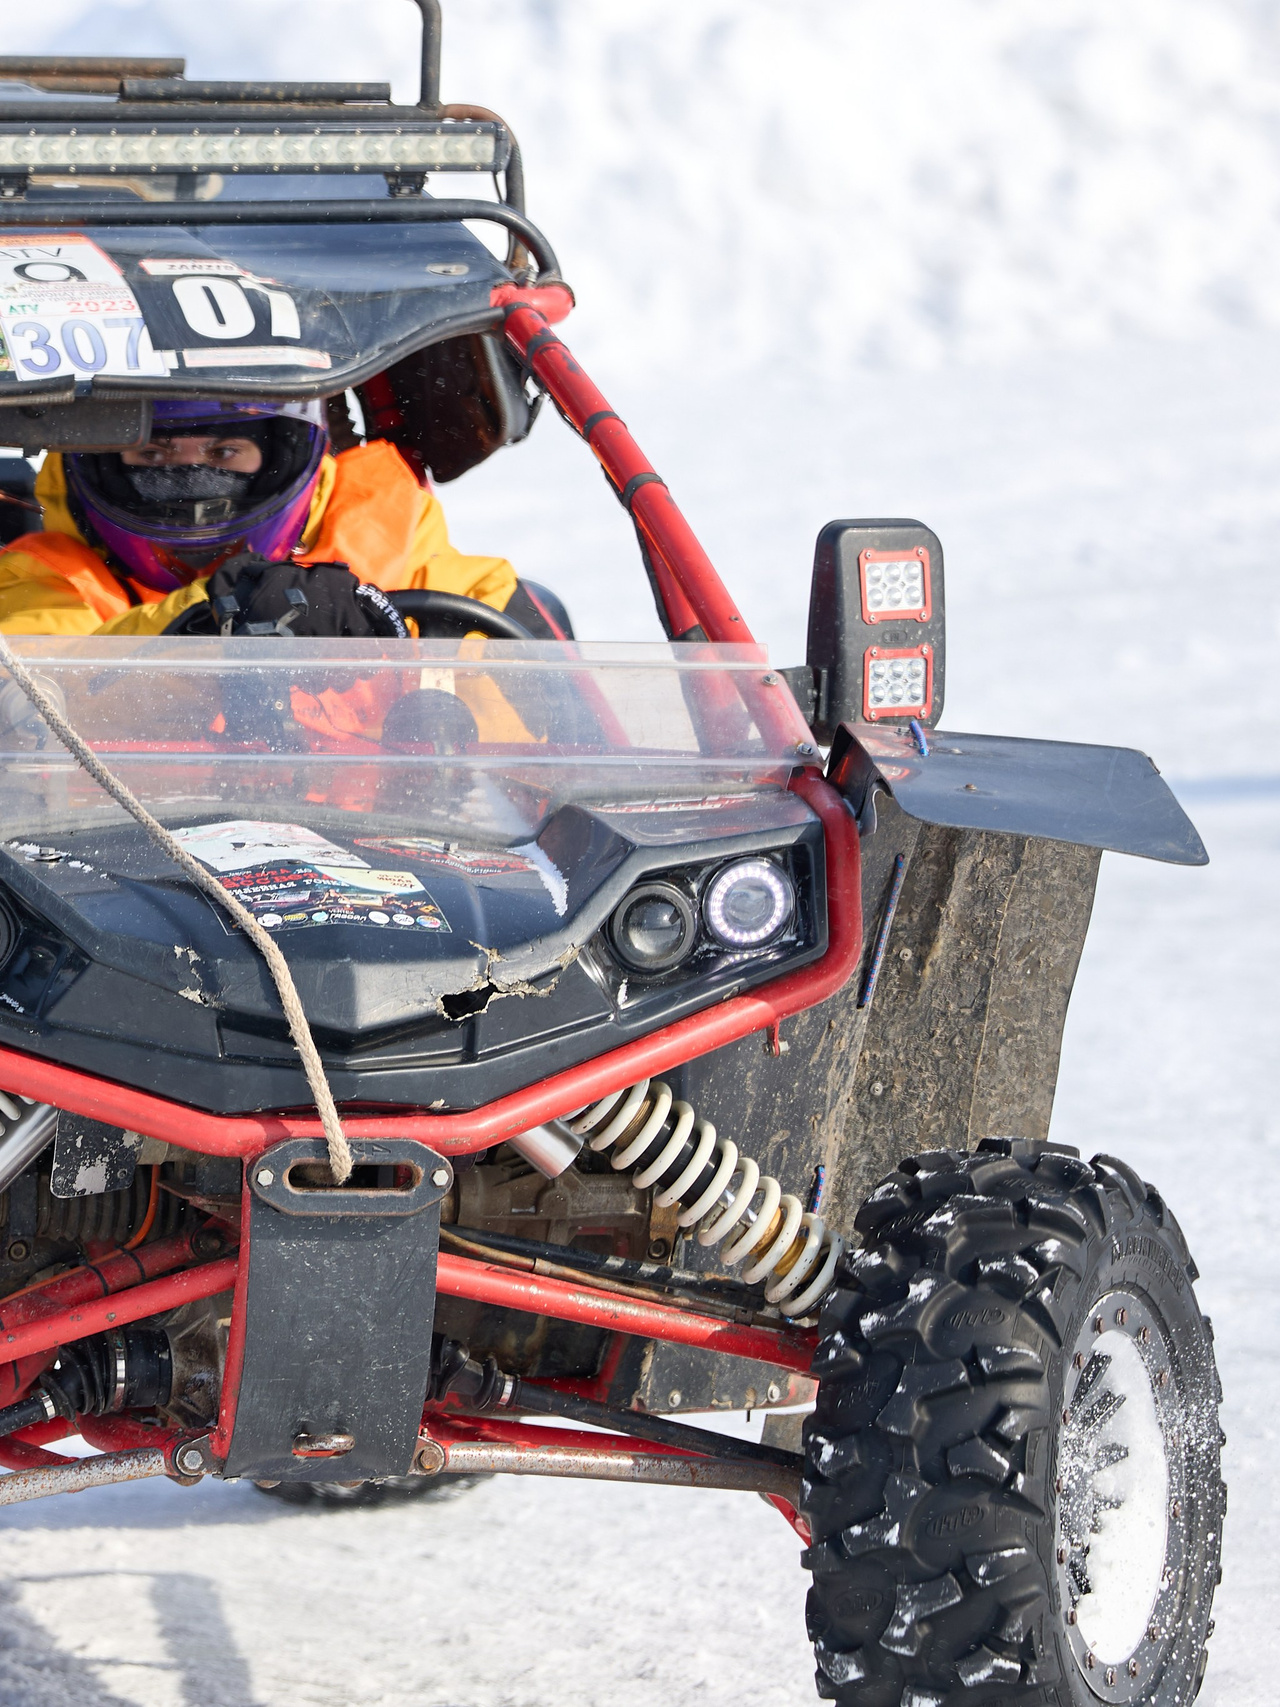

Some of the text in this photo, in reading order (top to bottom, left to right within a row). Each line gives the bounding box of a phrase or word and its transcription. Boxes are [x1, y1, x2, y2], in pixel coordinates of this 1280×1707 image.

[8, 300, 136, 315] ATV 2023
[11, 317, 146, 374] 307
